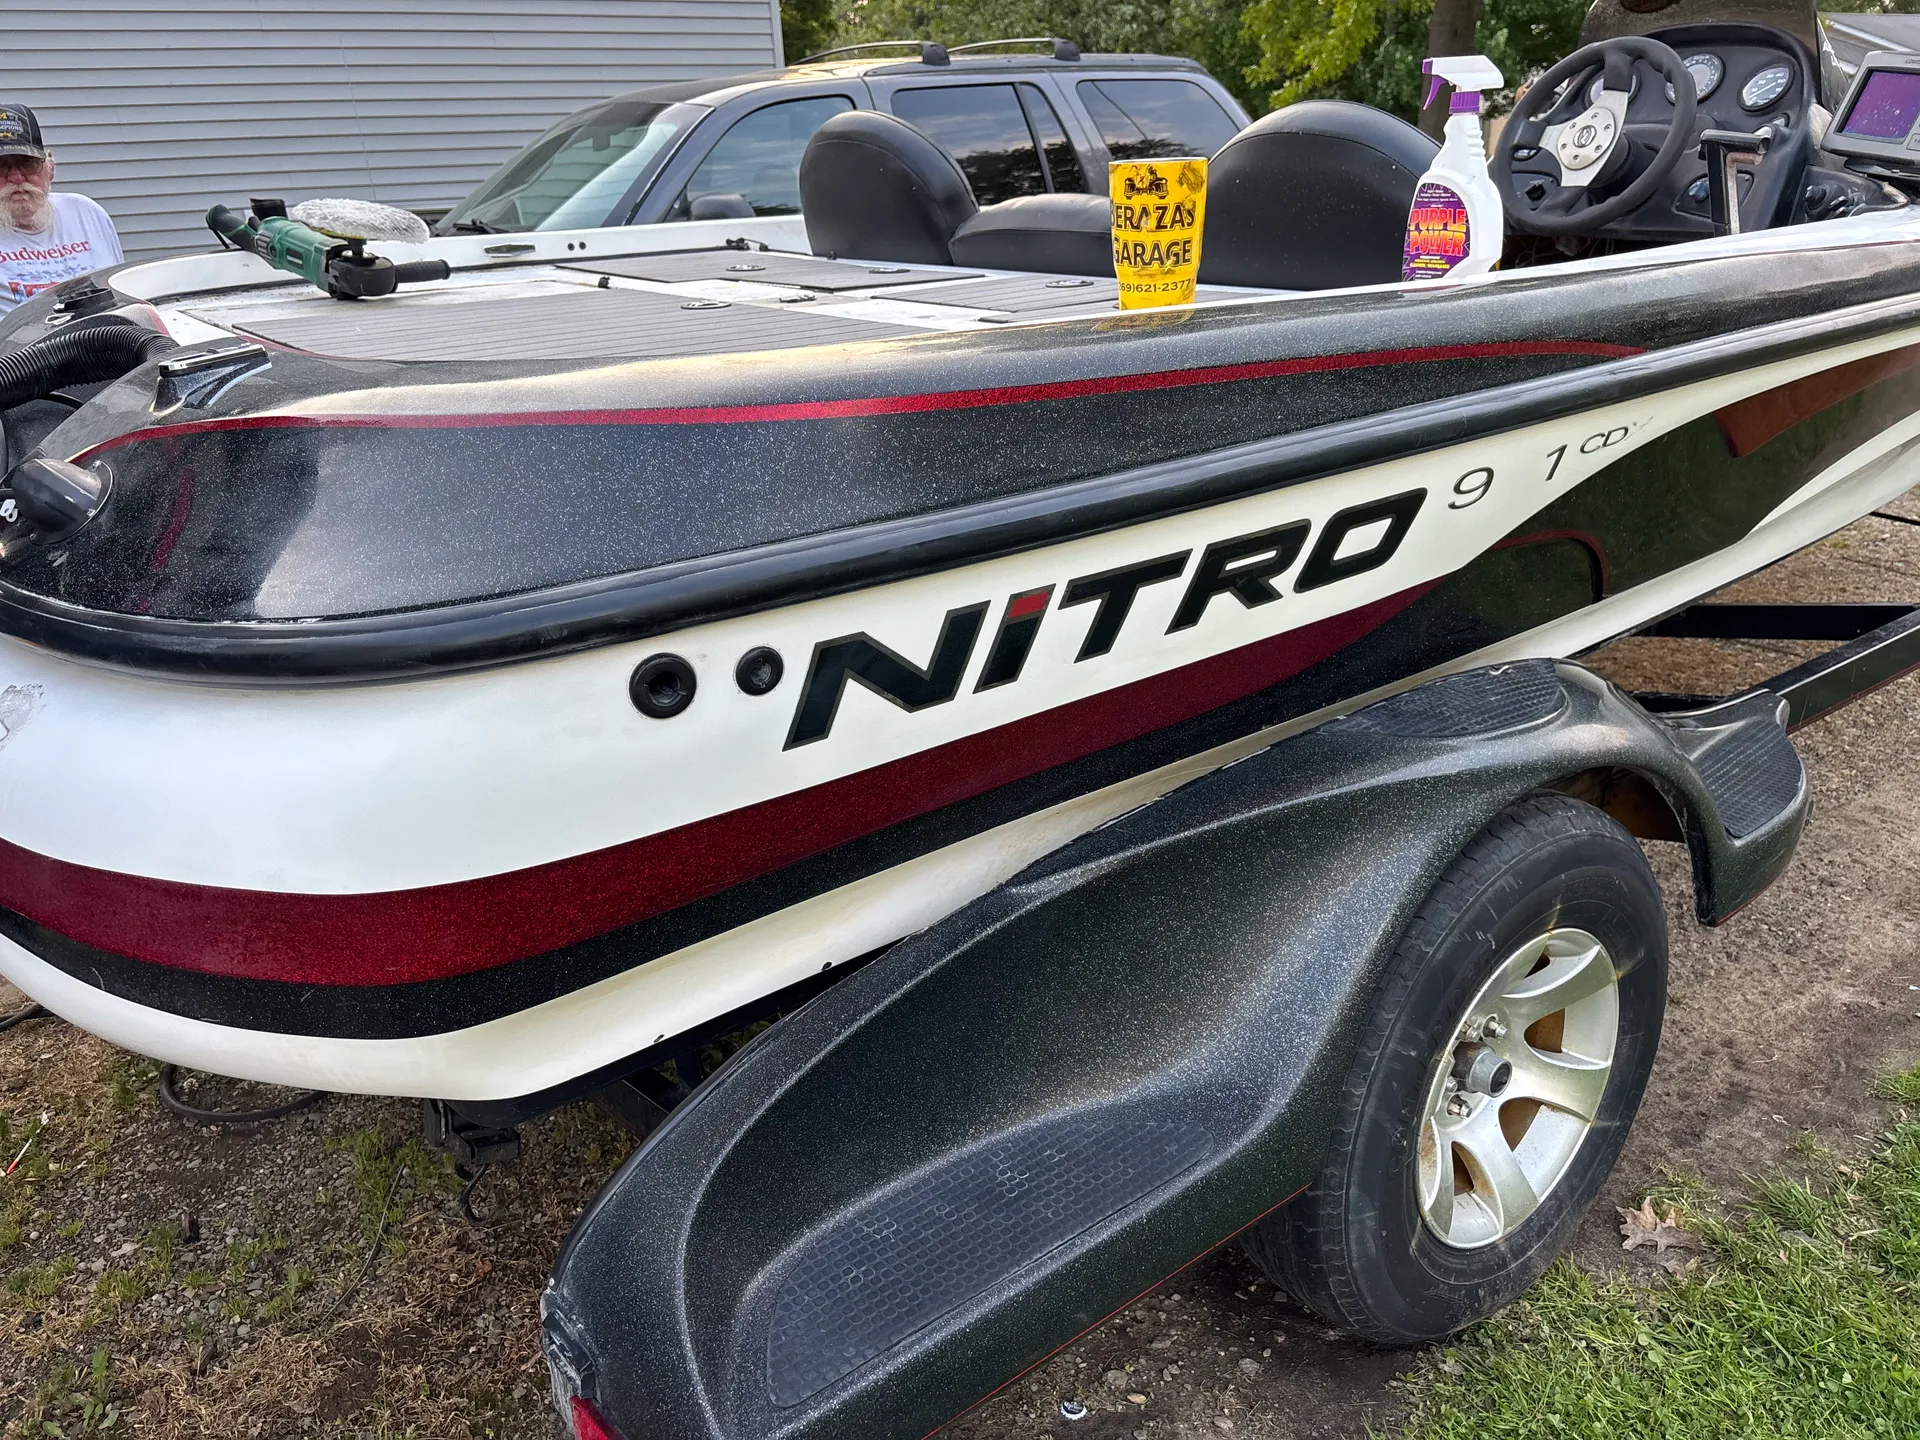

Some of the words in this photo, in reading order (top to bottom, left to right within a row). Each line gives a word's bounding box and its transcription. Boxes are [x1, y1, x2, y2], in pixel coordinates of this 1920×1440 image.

[1409, 207, 1466, 232] PURPLE
[1113, 235, 1192, 268] GARAGE
[1409, 230, 1466, 256] POWER
[1448, 467, 1494, 509] 9
[1545, 444, 1567, 481] 1
[1580, 421, 1640, 454] CD
